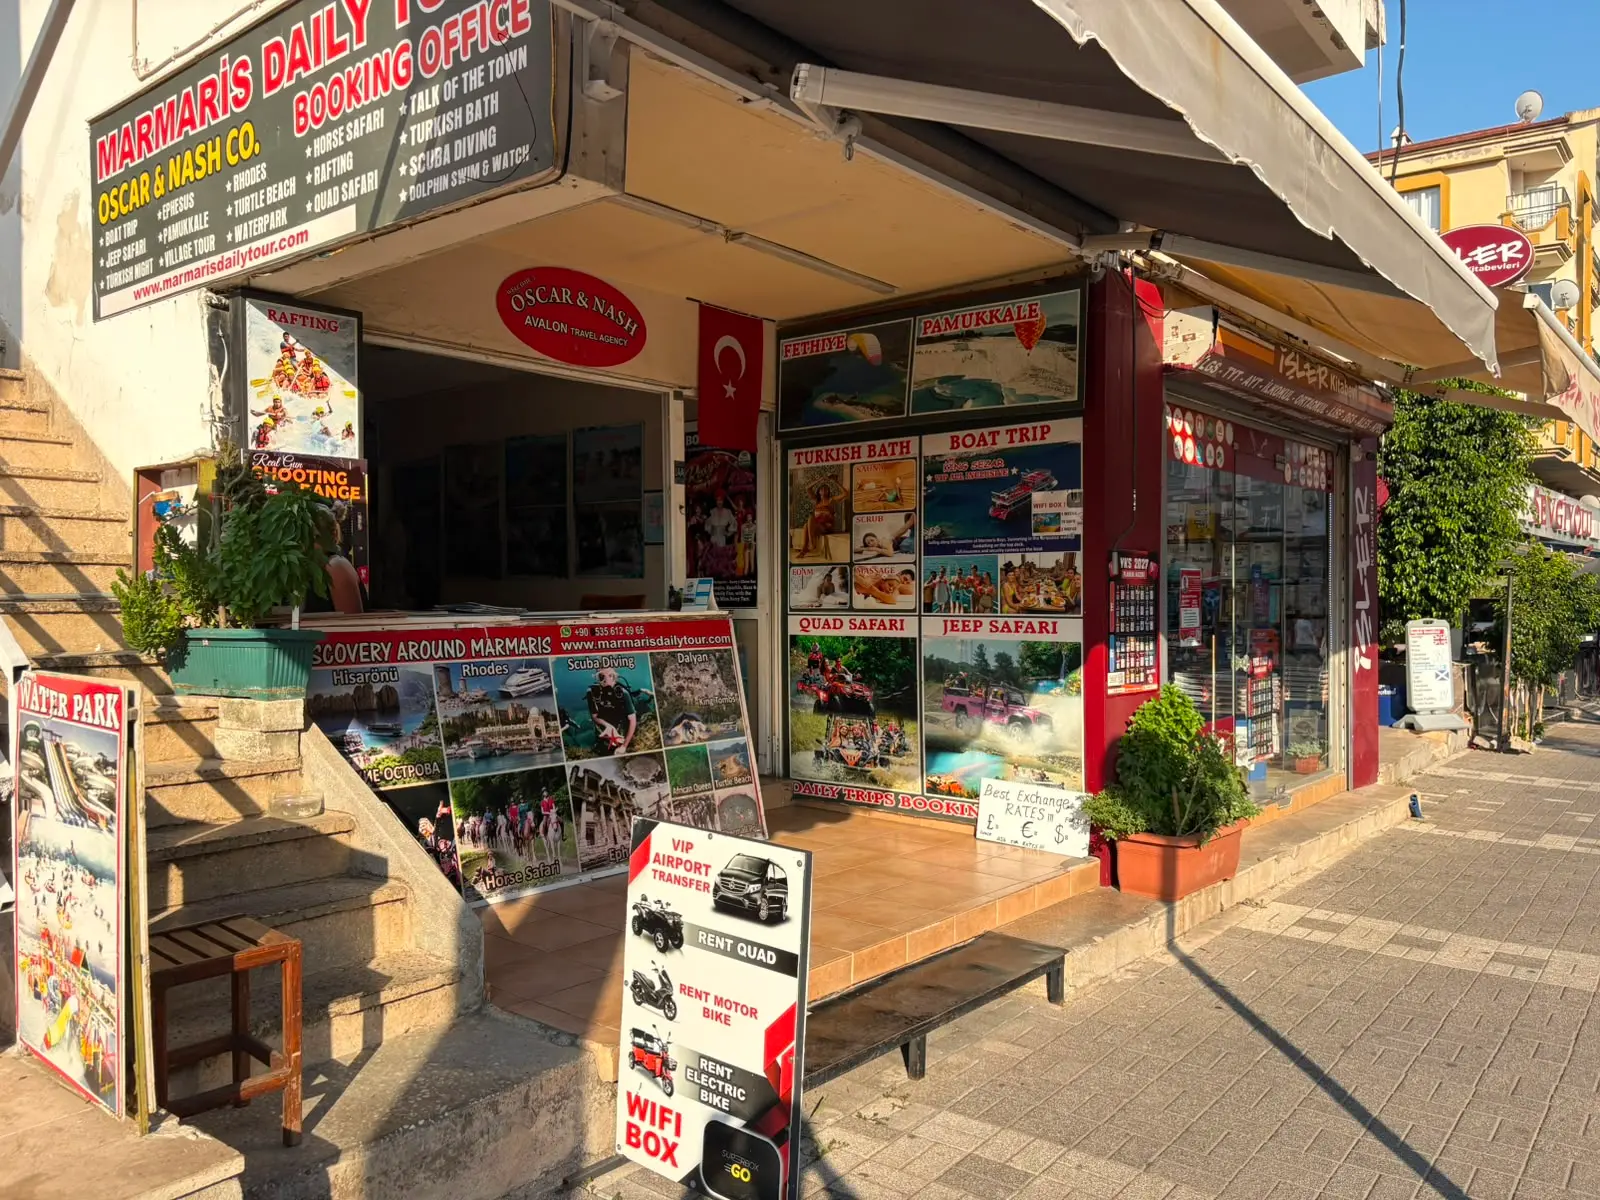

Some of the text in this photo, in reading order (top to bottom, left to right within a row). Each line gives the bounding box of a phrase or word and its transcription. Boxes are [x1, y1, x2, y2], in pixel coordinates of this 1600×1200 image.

[262, 0, 371, 98] DAILY
[293, 0, 531, 137] BOOKING OFFICE
[410, 45, 528, 116] TALK OF THE TOWN
[313, 108, 385, 158] HORSE SAFARI
[410, 91, 499, 146] TURKISH BATH
[409, 126, 497, 176] SCUBA DIVING
[98, 120, 260, 225] OSCAR & NASH CO.
[233, 163, 267, 193] RHODES
[314, 151, 353, 185] RAFTING
[409, 144, 530, 201] DOLPHIN SWIM & WATCH
[234, 176, 296, 218] TURTLE BEACH
[314, 169, 378, 213] QUAD SAFARI
[162, 193, 195, 220] EPHESUS
[105, 219, 138, 246] BOAT TRIP
[162, 211, 209, 244] PAMUKKALE
[234, 206, 288, 243] WATERPARK
[105, 238, 147, 268] JEEP SAFARI
[133, 229, 309, 300] www.marmarisdailytour.com
[164, 235, 216, 267] VILLAGE TOUR
[106, 258, 154, 290] TURKISH NIGHT
[267, 308, 339, 333] RAFTING
[511, 286, 638, 336] OSCAR & NASH
[921, 302, 1040, 336] PAMUKKALE
[525, 315, 628, 347] AVALON TRAVEL AGENCY
[783, 334, 847, 358] FETHIYE
[950, 425, 1051, 451] BOAT TRIP
[252, 453, 303, 469] Real Gun
[795, 441, 911, 465] TURKISH BATH
[594, 627, 609, 636] 535
[610, 626, 624, 636] 612
[799, 617, 905, 632] QUAD SAFARI
[942, 619, 1058, 635] JEEP SAFARI
[397, 639, 465, 661] AROUND
[471, 636, 552, 658] MARMARIS
[561, 635, 732, 651] www.marmarisdailytour.com
[462, 661, 509, 677] Rhodes
[567, 655, 635, 671] Scuba Diving
[677, 652, 709, 665] Dalyan
[332, 666, 399, 686] Hisarönü
[20, 679, 120, 729] WATER PARK
[383, 761, 441, 781] ОСТРОВА
[714, 776, 752, 789] Turtle Beach
[693, 782, 711, 794] Queen
[793, 781, 839, 799] DAILY
[843, 787, 894, 805] TRIPS
[984, 784, 1070, 813] Best Exchange
[1005, 803, 1046, 821] RATES
[672, 838, 694, 854] VIP
[485, 860, 561, 891] Horse Safari
[652, 852, 712, 877] AIRPORT
[651, 868, 711, 894] TRANSFER
[698, 930, 777, 965] RENT QUAD
[679, 983, 758, 1020] RENT MOTOR
[702, 1006, 731, 1026] BIKE
[685, 1065, 746, 1101] ELECTRIC
[699, 1057, 733, 1080] RENT
[626, 1090, 682, 1139] WIFI
[699, 1089, 730, 1111] BIKE
[625, 1120, 679, 1169] BOX
[731, 1163, 751, 1182] GO
